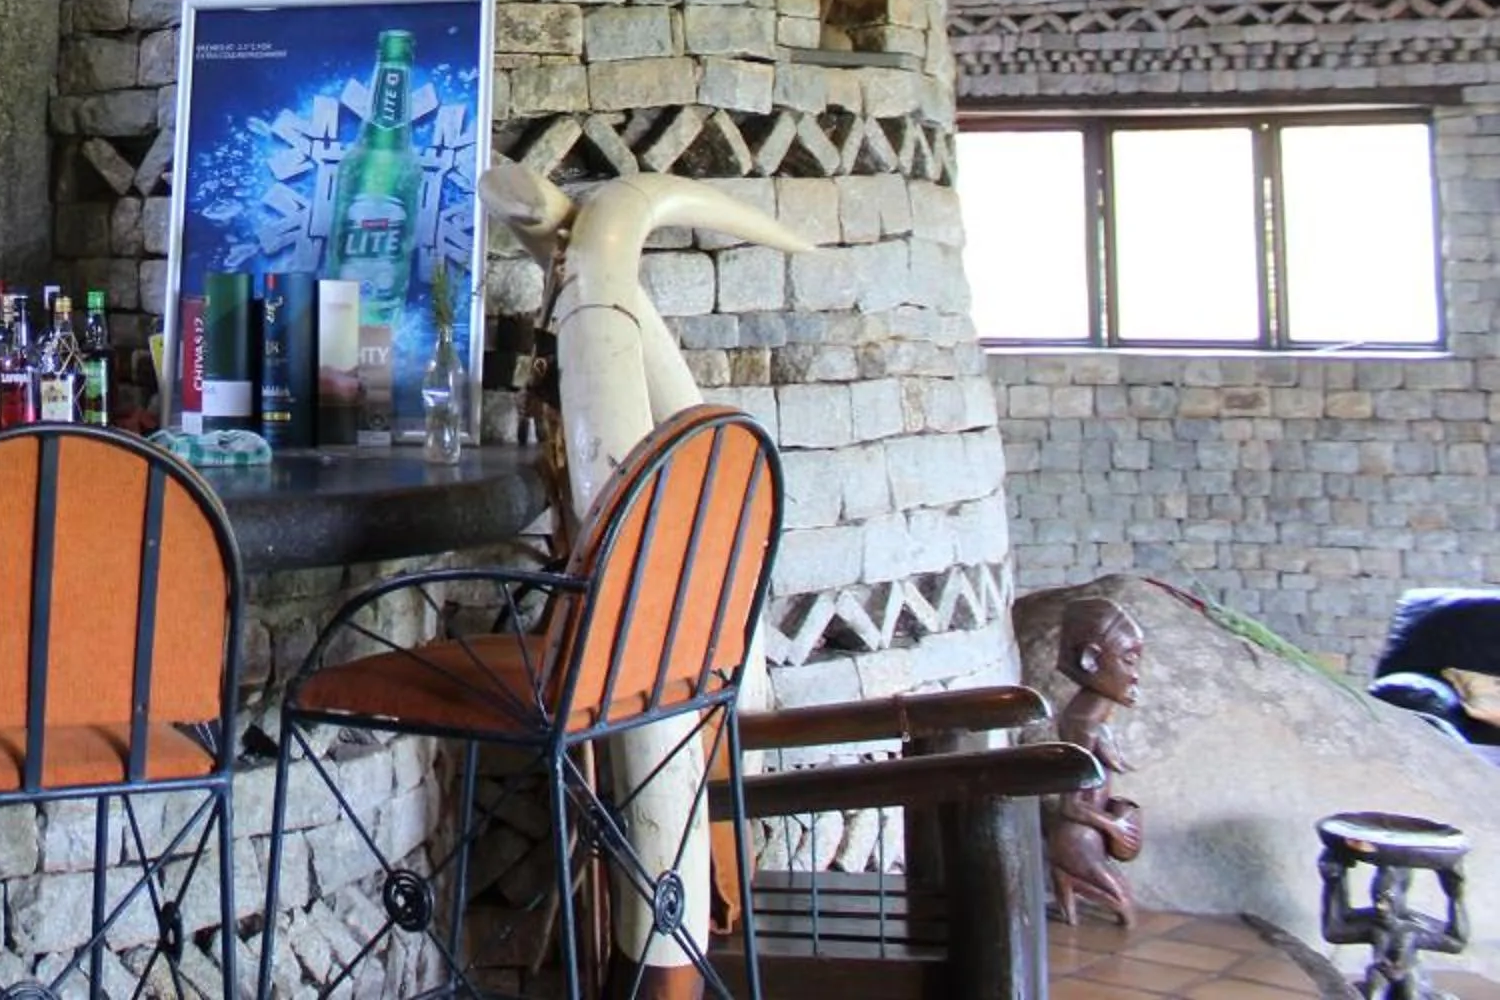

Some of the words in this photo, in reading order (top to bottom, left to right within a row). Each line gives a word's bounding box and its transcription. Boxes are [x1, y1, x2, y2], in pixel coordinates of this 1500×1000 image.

[383, 88, 397, 121] LITE
[345, 230, 400, 255] LITE
[193, 335, 204, 391] CHIVAS
